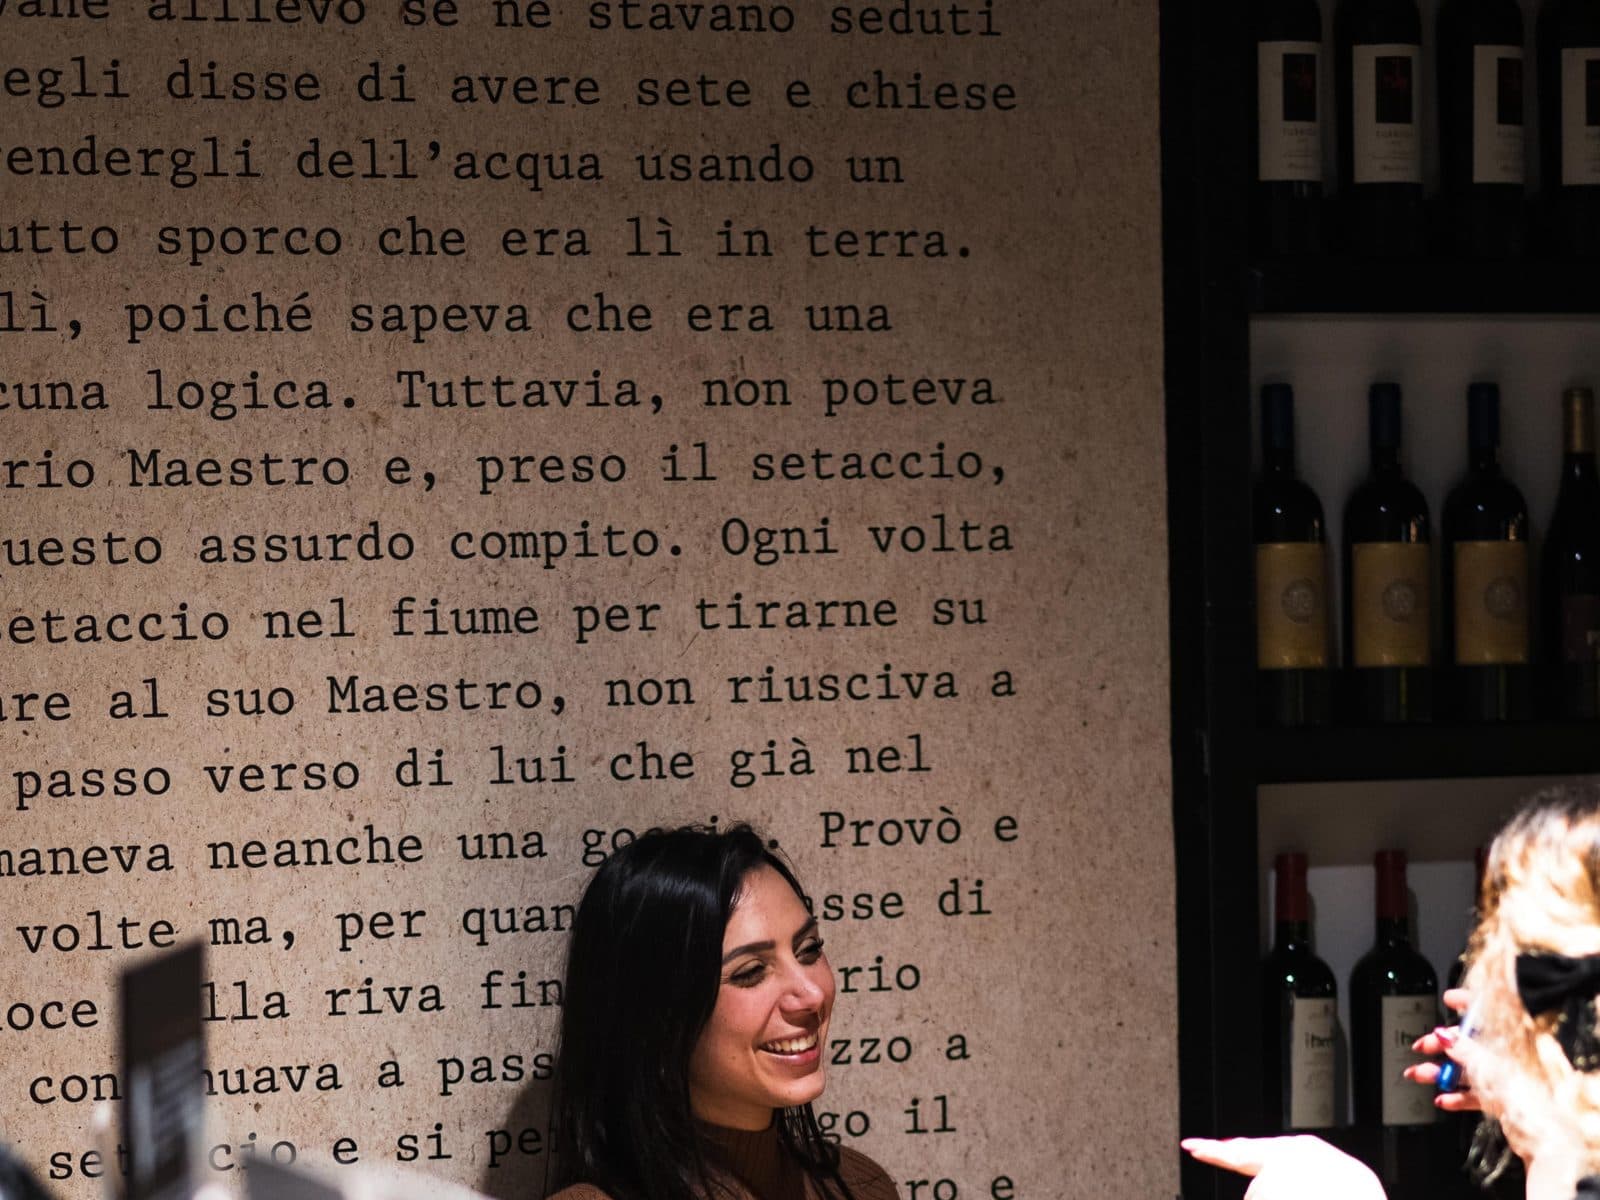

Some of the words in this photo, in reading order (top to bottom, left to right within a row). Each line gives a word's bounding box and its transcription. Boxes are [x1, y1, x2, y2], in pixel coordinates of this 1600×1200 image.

[0, 0, 110, 20] ane
[398, 0, 459, 27] se
[491, 0, 552, 29] ne
[588, 0, 795, 33] stavano
[830, 0, 1002, 37] seduti
[3, 55, 131, 109] egli
[166, 58, 321, 102] disse
[357, 61, 417, 103] di
[451, 75, 601, 106] avere
[637, 74, 752, 108] sete
[785, 79, 812, 109] e
[846, 69, 1017, 112] chiese
[635, 142, 814, 183] usando
[845, 156, 905, 184] un
[157, 226, 342, 267] sporco
[378, 215, 466, 257] che
[501, 228, 592, 257] era
[626, 215, 682, 257] lì
[716, 219, 774, 257] in
[804, 225, 970, 259] terra.
[124, 291, 313, 345] poiché
[350, 303, 533, 344] sapeva
[566, 291, 653, 333] che
[687, 304, 775, 332] era
[804, 304, 893, 332] una
[146, 368, 356, 422] logica.
[396, 369, 663, 415] Tuttavia,
[701, 378, 793, 407] non
[821, 373, 999, 418] poteva
[2, 449, 95, 489] rio
[126, 448, 350, 488] Maestro
[384, 456, 436, 493] e,
[475, 454, 627, 496] preso
[661, 441, 718, 482] il
[752, 441, 1005, 486] setaccio,
[199, 520, 415, 564] assurdo
[450, 519, 682, 570] compito.
[721, 516, 839, 567] Ogni
[867, 513, 1014, 553] volta
[262, 596, 356, 639] nel
[391, 596, 540, 636] fiume
[572, 603, 662, 645] per
[695, 592, 898, 631] tirarne
[932, 598, 988, 626] su
[109, 677, 169, 720] al
[206, 686, 295, 717] suo
[326, 675, 566, 717] Maestro,
[604, 677, 696, 707] non
[727, 663, 959, 704] riusciva
[990, 670, 1017, 698] a
[12, 766, 171, 812] passo
[202, 760, 360, 794] verso
[395, 747, 454, 788] di
[489, 744, 576, 785] lui
[609, 740, 695, 782] che
[729, 736, 816, 789] già
[844, 733, 932, 774] nel
[206, 823, 424, 870] neanche
[456, 830, 548, 861] una
[818, 805, 962, 849] Provò
[993, 815, 1019, 843] e
[15, 909, 176, 954] volte
[207, 916, 295, 951] ma,
[334, 909, 427, 953] per
[937, 877, 993, 917] di
[324, 976, 446, 1017] riva
[377, 1060, 405, 1088] a
[945, 1033, 971, 1061] a
[332, 1137, 359, 1165] e
[396, 1122, 453, 1162] si
[903, 1094, 957, 1135] il
